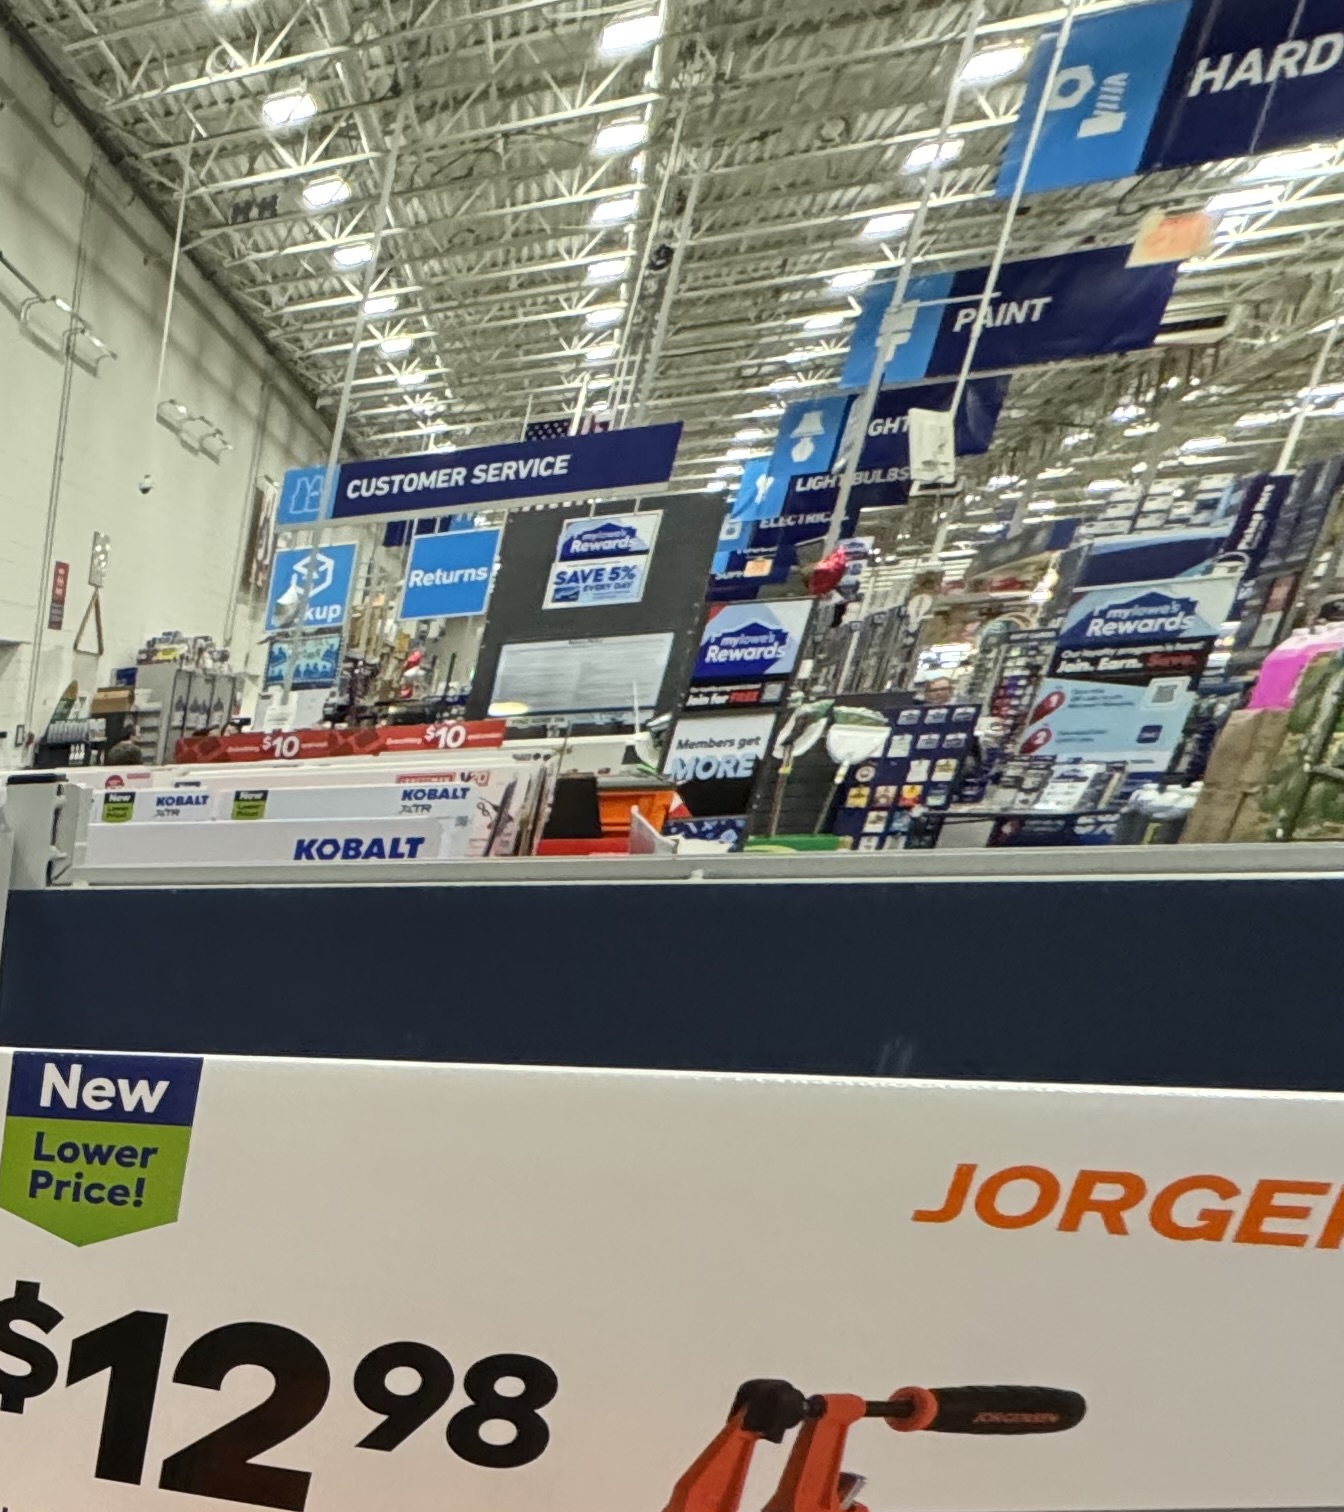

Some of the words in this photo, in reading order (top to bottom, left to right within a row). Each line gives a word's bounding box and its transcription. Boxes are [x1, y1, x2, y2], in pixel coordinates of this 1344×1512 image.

[953, 296, 1052, 333] PAINT
[346, 467, 465, 499] CUSTOMER
[470, 454, 572, 485] SERVICE
[569, 534, 637, 553] Rewards
[408, 564, 489, 588] Returns
[554, 568, 605, 586] SAVE
[608, 565, 637, 582] 5%
[1086, 613, 1195, 638] Rewards
[705, 642, 786, 663] Rewards
[263, 734, 300, 757] $10
[424, 725, 466, 749] $10
[676, 738, 735, 750] Members
[737, 736, 761, 750] get
[670, 752, 757, 781] MORE
[155, 794, 209, 808] KOBALT
[401, 787, 470, 801] KOBALT
[293, 836, 425, 860] KOBALT
[40, 1063, 169, 1113] New
[33, 1131, 158, 1169] Lower
[27, 1169, 144, 1208] Price!
